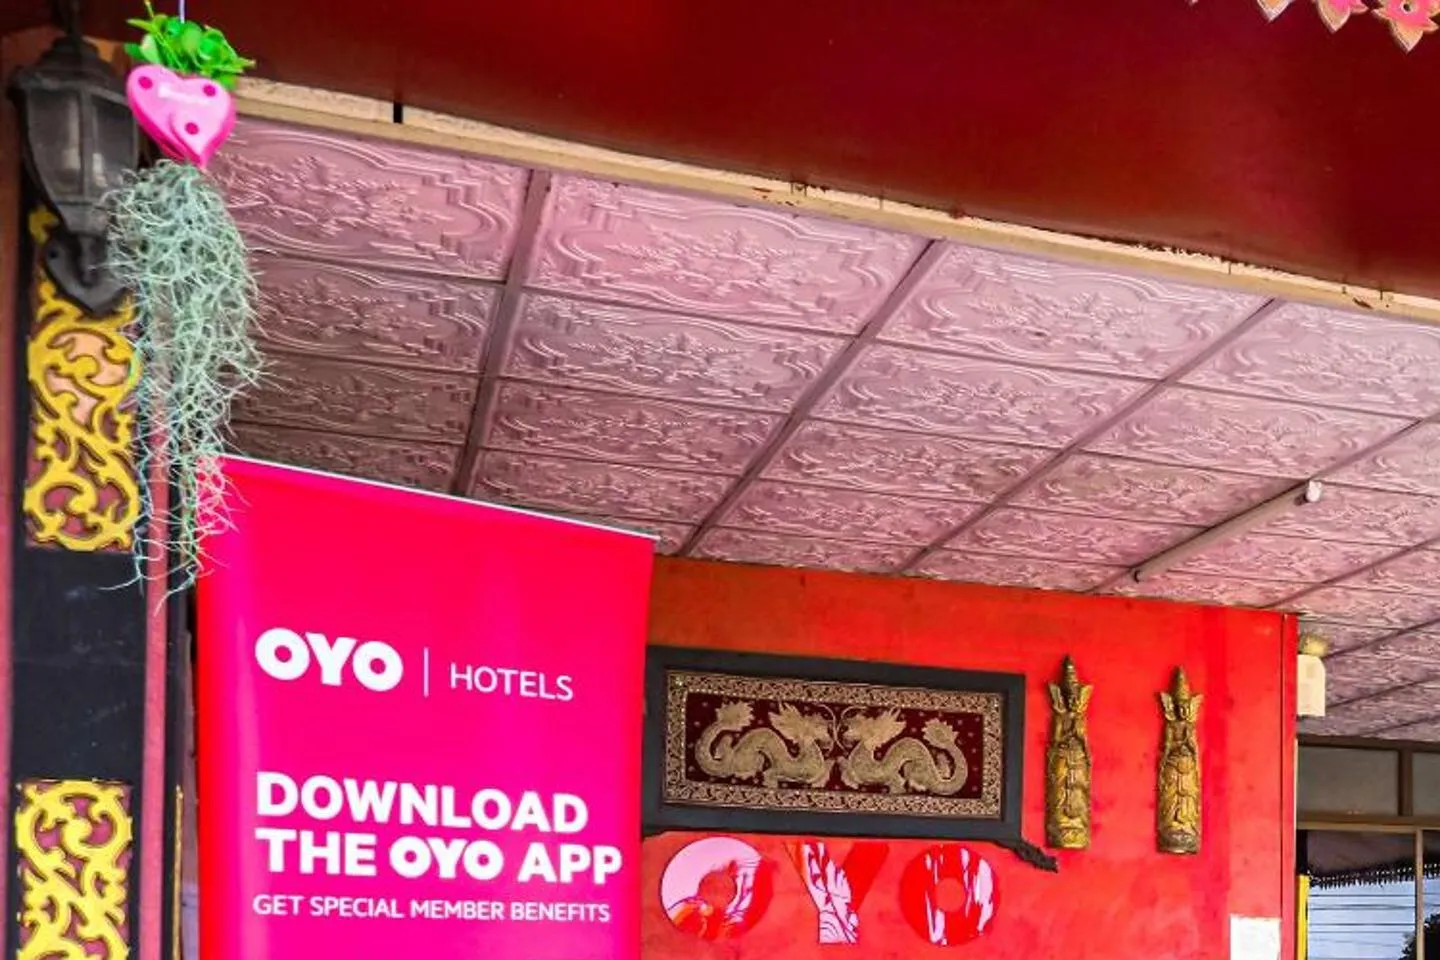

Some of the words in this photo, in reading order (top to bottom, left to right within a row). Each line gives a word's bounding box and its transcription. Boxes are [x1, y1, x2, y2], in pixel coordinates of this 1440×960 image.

[255, 627, 403, 692] OYO
[450, 662, 574, 701] HOTELS
[256, 771, 588, 833] DOWNLOAD
[255, 829, 377, 877] THE
[389, 836, 503, 880] OYO
[518, 844, 622, 885] APP
[253, 894, 303, 916] GET
[310, 895, 404, 919] SPECIAL
[411, 898, 504, 920] MEMBER
[511, 901, 610, 923] BENEFITS
